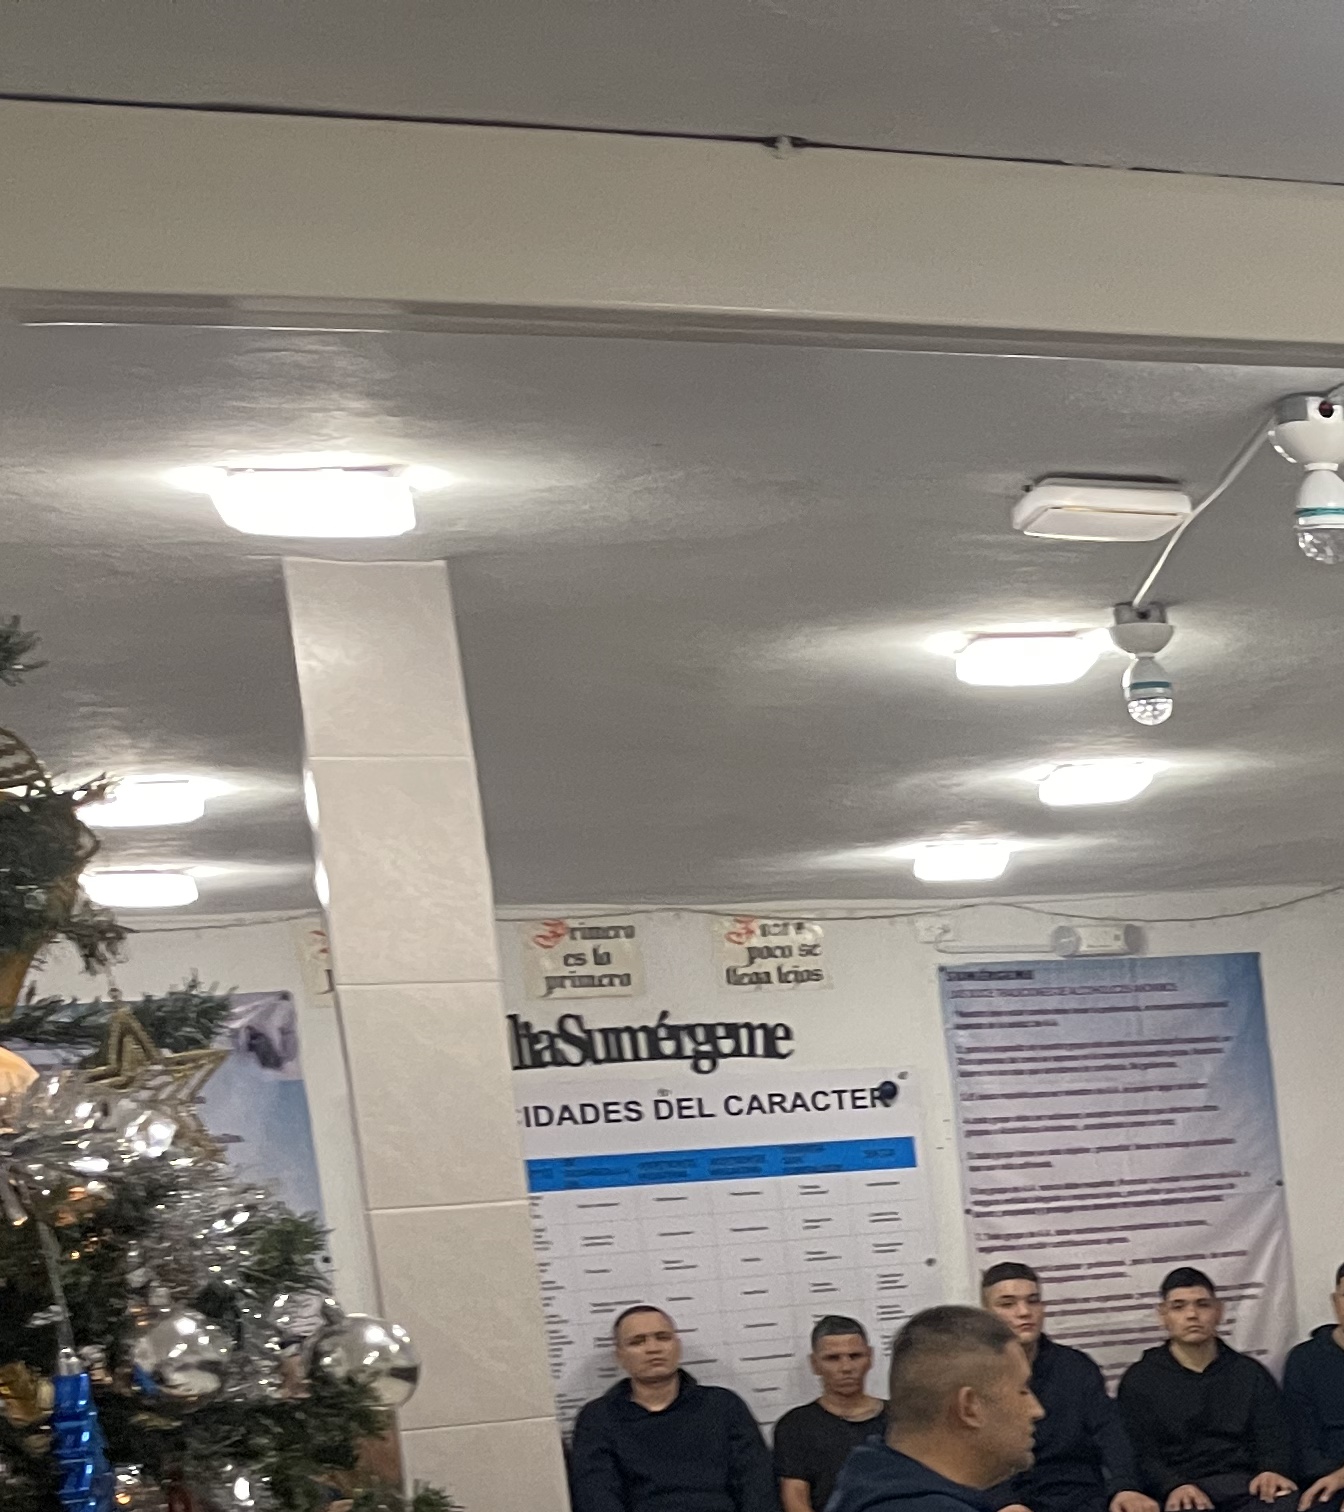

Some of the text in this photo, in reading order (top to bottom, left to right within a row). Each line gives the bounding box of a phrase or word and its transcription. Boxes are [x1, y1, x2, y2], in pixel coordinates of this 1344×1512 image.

[517, 1086, 893, 1128] IDADES DEL CARACTER
